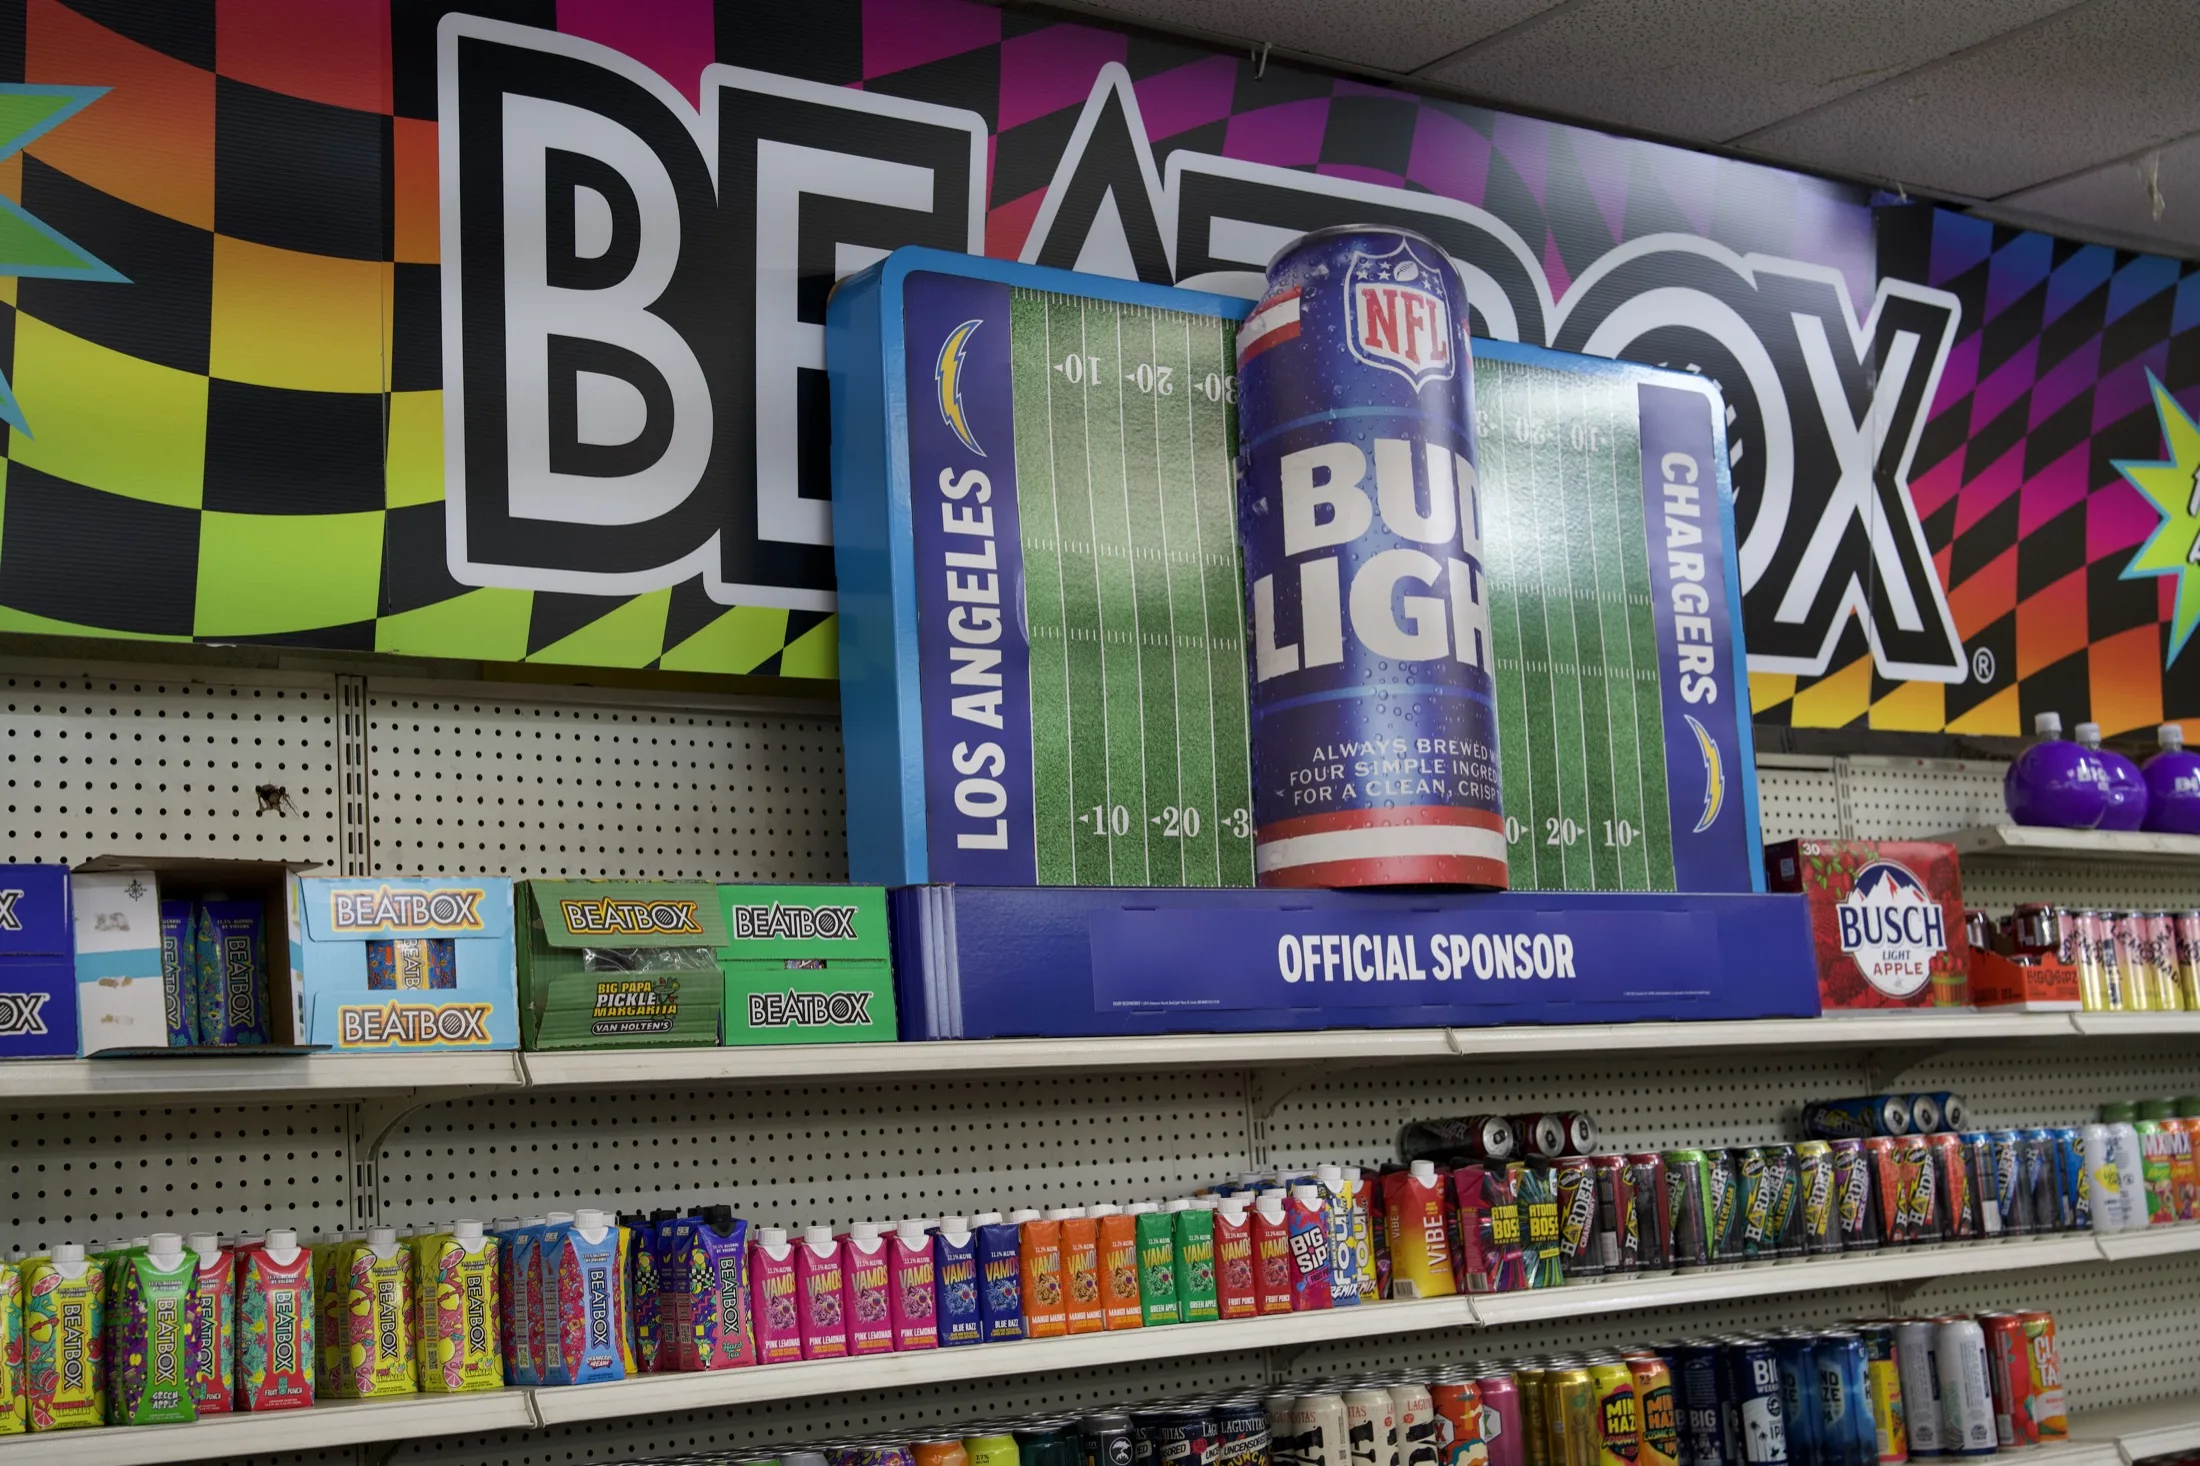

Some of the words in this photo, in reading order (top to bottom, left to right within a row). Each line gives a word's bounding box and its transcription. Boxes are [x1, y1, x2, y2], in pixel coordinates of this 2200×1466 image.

[1361, 288, 1448, 366] NFL
[1660, 451, 1718, 706] CHARGERS
[938, 466, 1004, 730] ANGELES
[1312, 738, 1408, 763] ALWAYS
[1416, 738, 1489, 761] BREWED
[1290, 763, 1345, 787] FOUR
[1354, 758, 1446, 778] SIMPLE
[951, 740, 1008, 850] LOS
[1294, 785, 1331, 805] FOR
[1341, 783, 1357, 799] A
[1365, 779, 1453, 800] CLEAN,
[1092, 805, 1130, 836] 10
[1162, 806, 1200, 837] 20
[1545, 817, 1577, 847] 20
[1602, 819, 1633, 847] 10
[1802, 842, 1821, 857] 30
[335, 889, 481, 930] BEATBOX
[563, 899, 700, 932] BEATBOX
[734, 902, 859, 939] BEATBOX
[1840, 904, 1945, 949] BUSCH
[1278, 934, 1426, 983] OFFICIAL
[1430, 933, 1576, 980] SPONSOR
[1873, 961, 1924, 977] APPLE
[1881, 950, 1911, 961] LIGHT
[227, 938, 252, 1023] BEATBOX
[597, 983, 619, 994] BIG
[621, 981, 652, 993] PAPA
[596, 992, 657, 1008] PICKLE
[748, 990, 873, 1027] BEATBOX
[344, 1003, 487, 1043] BEATBOX
[596, 1024, 618, 1032] VAN
[620, 1021, 669, 1031] HOLTEN'S
[1561, 1176, 1594, 1257] HARDER
[1067, 1249, 1097, 1274] VAMO
[590, 1267, 609, 1349] BEATBOX
[720, 1257, 740, 1336] BEATBOX
[378, 1280, 399, 1360] BEATBOX
[466, 1274, 487, 1355] BEATBOX
[952, 1323, 965, 1332] BLUE
[994, 1320, 1007, 1329] BLUE
[63, 1303, 84, 1392] BEATBOX
[156, 1298, 178, 1384] BEATBOX
[274, 1290, 297, 1373] BEATBOX
[765, 1340, 778, 1349] PINK
[809, 1336, 822, 1345] PINK
[854, 1332, 867, 1341] PINK
[901, 1329, 913, 1337] PINK
